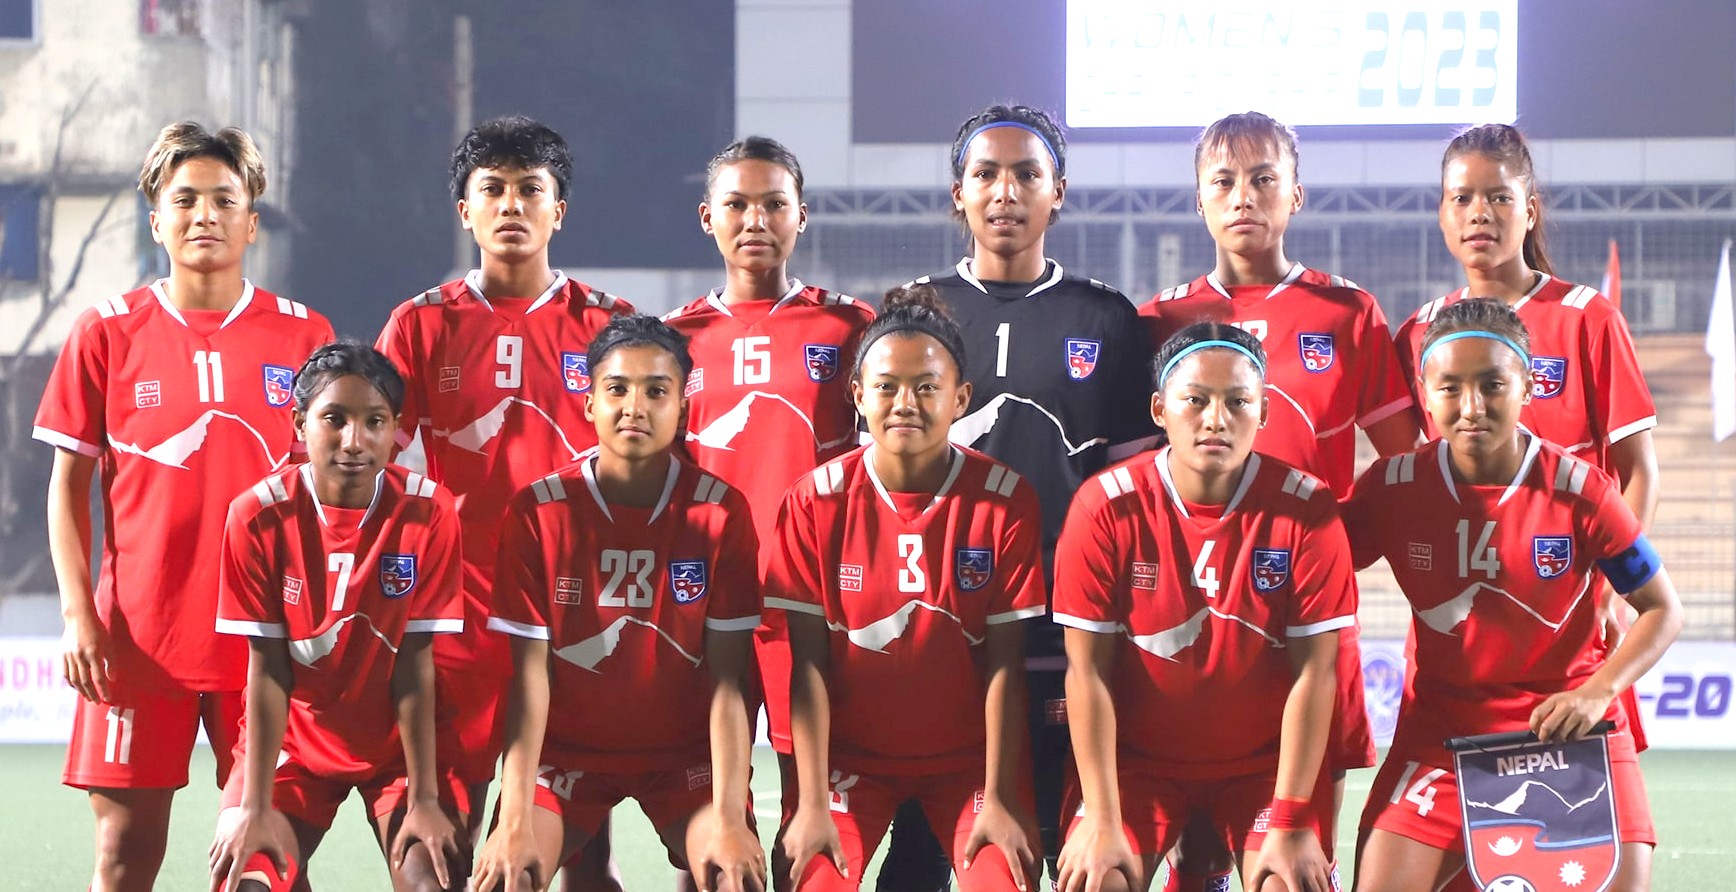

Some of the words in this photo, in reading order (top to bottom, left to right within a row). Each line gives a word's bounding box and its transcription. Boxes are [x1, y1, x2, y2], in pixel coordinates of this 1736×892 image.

[1084, 12, 1344, 48] WOMENS
[1358, 11, 1500, 107] 2023
[495, 335, 523, 388] 9
[731, 336, 770, 385] 15
[995, 323, 1010, 377] 1
[137, 384, 158, 393] KTM
[139, 396, 158, 405] CTY
[193, 350, 224, 402] 11
[840, 567, 860, 576] KTM
[898, 534, 925, 592] 3
[1134, 565, 1155, 574] KTM
[1190, 540, 1220, 598] 4
[1455, 519, 1500, 579] 14
[328, 553, 355, 611] 7
[557, 593, 577, 602] CTY
[558, 580, 579, 590] KTM
[598, 549, 655, 607] 23
[840, 579, 859, 588] CTY
[1133, 578, 1154, 587] CTY
[105, 706, 135, 764] 11
[1497, 750, 1569, 777] NEPAL
[1389, 761, 1448, 817] 14
